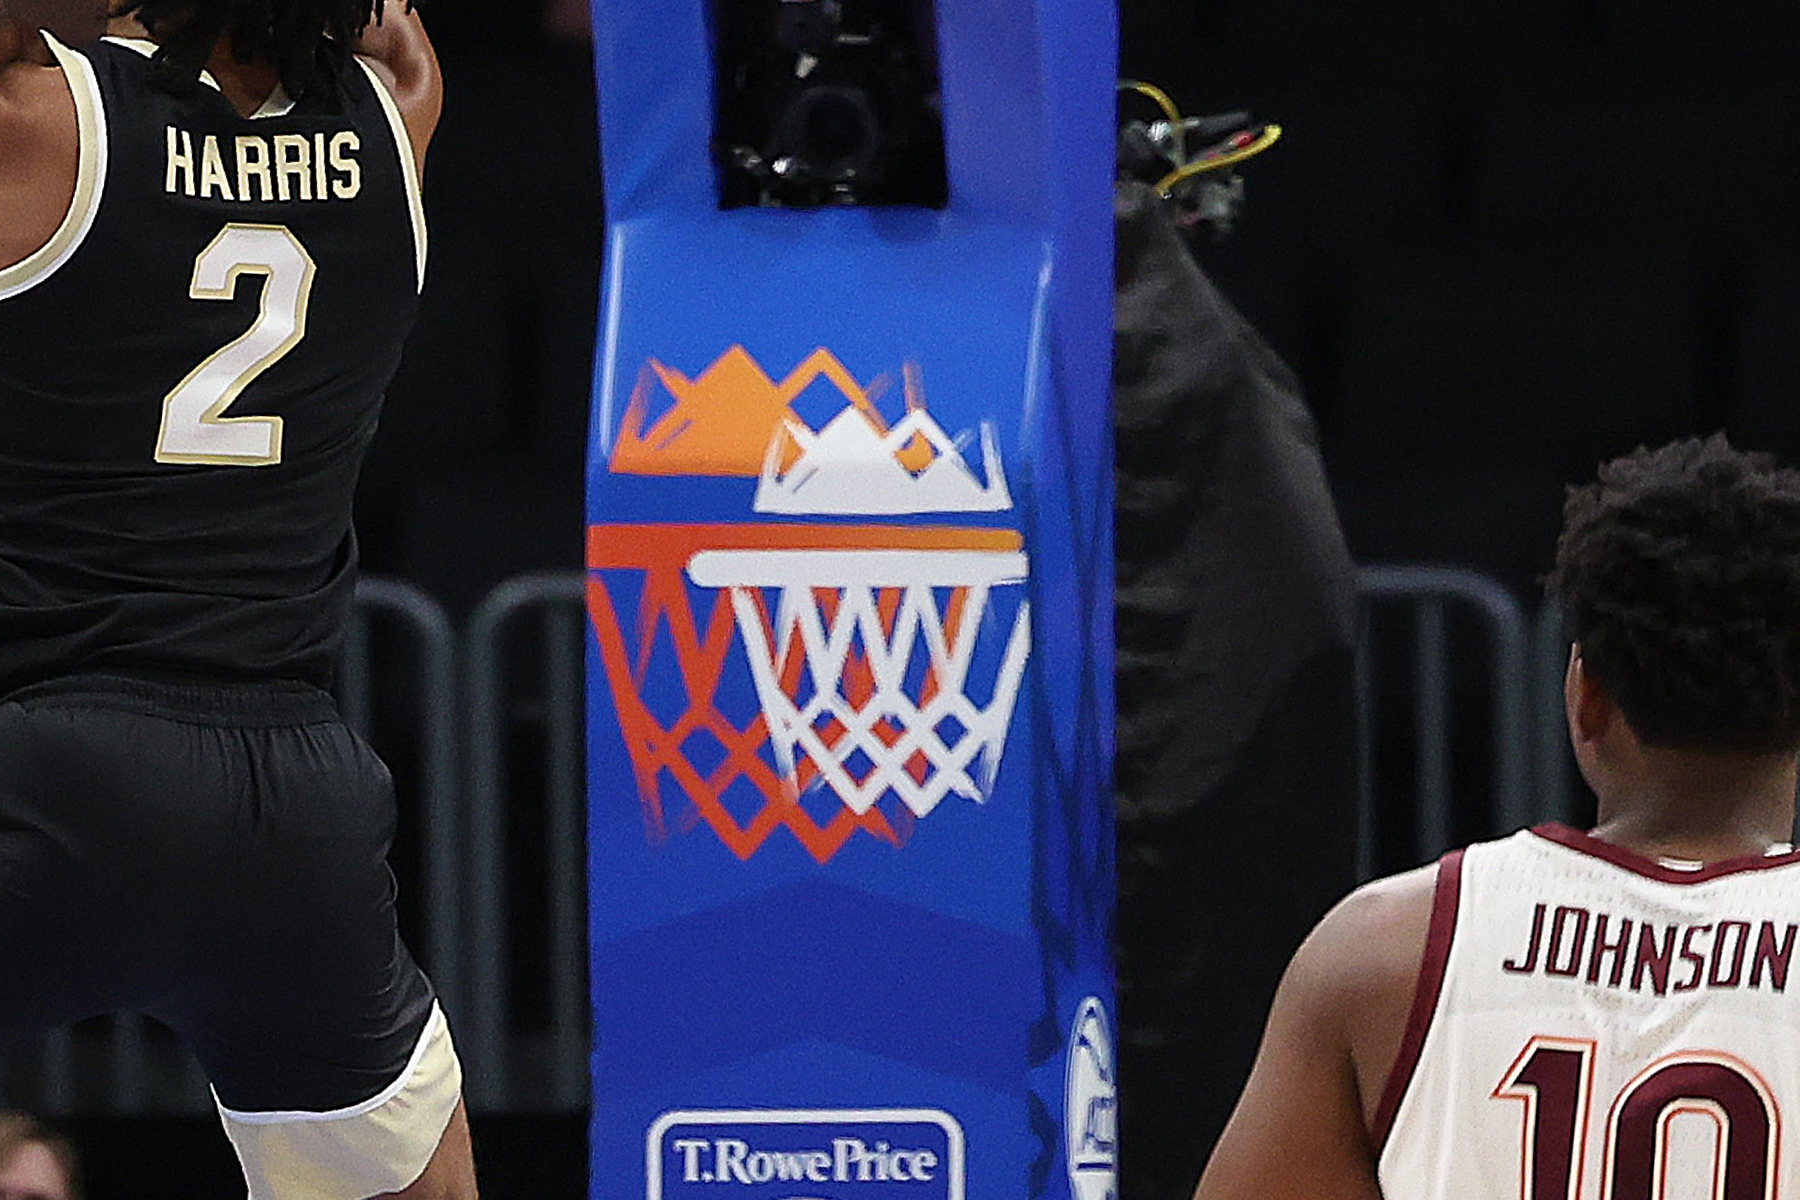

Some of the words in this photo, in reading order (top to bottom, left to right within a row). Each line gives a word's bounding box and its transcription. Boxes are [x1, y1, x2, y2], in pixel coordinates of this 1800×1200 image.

[165, 125, 362, 201] HARRIS
[154, 222, 317, 464] 2
[1502, 902, 1799, 998] JOHNSON
[1490, 1034, 1782, 1200] 10
